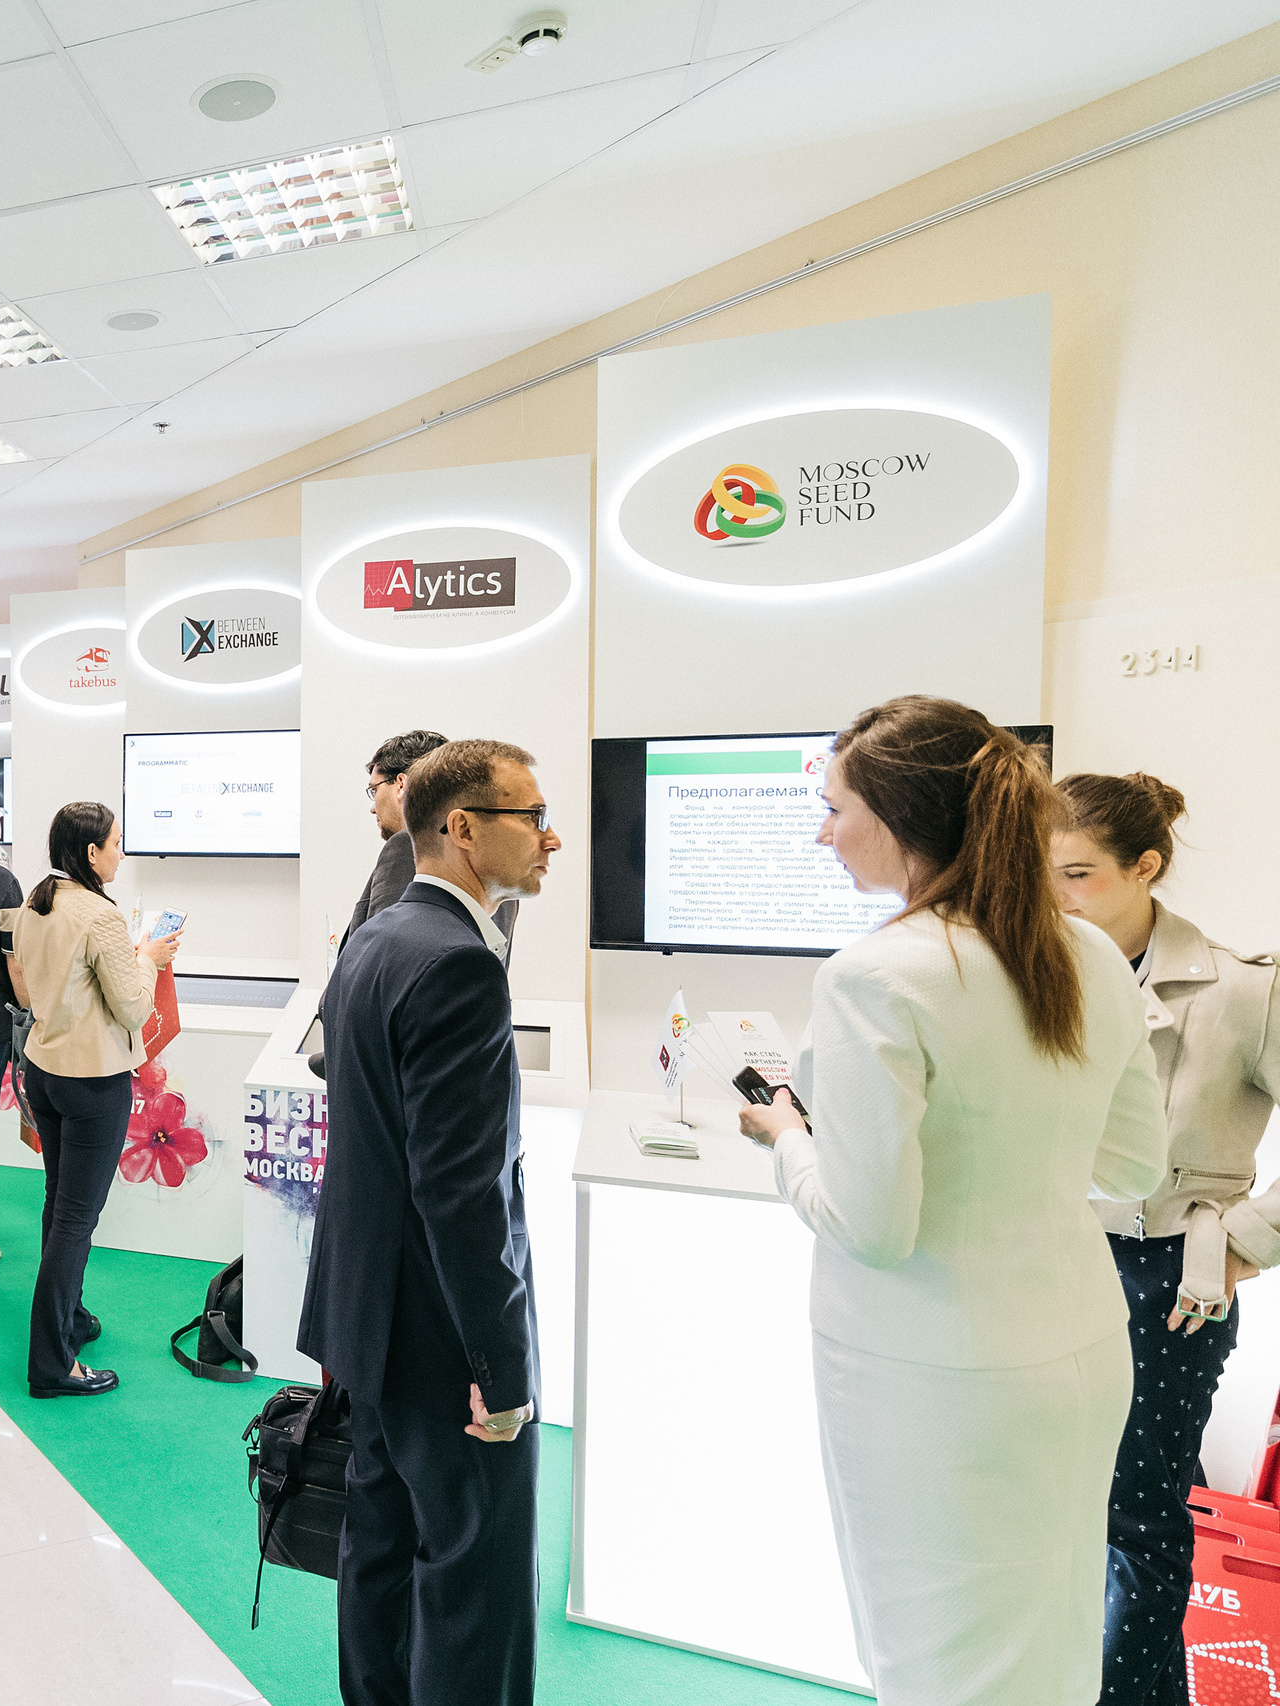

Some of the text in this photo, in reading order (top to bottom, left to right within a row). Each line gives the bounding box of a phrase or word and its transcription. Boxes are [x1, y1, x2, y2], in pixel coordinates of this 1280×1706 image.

[799, 452, 931, 485] MOSCOW
[798, 481, 871, 505] SEED
[799, 502, 876, 526] FUND
[386, 565, 502, 606] Alytics
[393, 612, 442, 621] ОПТИМИЗИРУЕМ
[480, 609, 516, 617] КОНВЕРСИИ
[217, 617, 266, 633] BETWEEN
[218, 631, 279, 650] EXCHANGE
[1120, 644, 1201, 679] 2344
[69, 675, 117, 688] takebus
[137, 759, 189, 767] PROGRAMMATIC
[231, 782, 274, 793] EXCHANGE
[668, 785, 808, 800] Предполагаемая
[684, 804, 706, 812] Фонд
[732, 804, 776, 812] конкурсной
[670, 820, 691, 828] берет
[670, 829, 702, 837] проекты
[707, 839, 739, 847] каждого
[751, 839, 791, 847] инвестора
[670, 847, 717, 855] выделяемых
[670, 855, 705, 863] Инвестор
[773, 856, 816, 864] принимает
[685, 880, 722, 889] Средства
[723, 881, 750, 889] Фонда
[685, 898, 722, 907] Перечень
[726, 900, 770, 908] инвесторов
[669, 906, 733, 915] Попечительского
[813, 910, 850, 918] Решение
[716, 916, 742, 924] проект
[669, 923, 696, 931] рамках
[244, 1157, 325, 1184] МОСКВА
